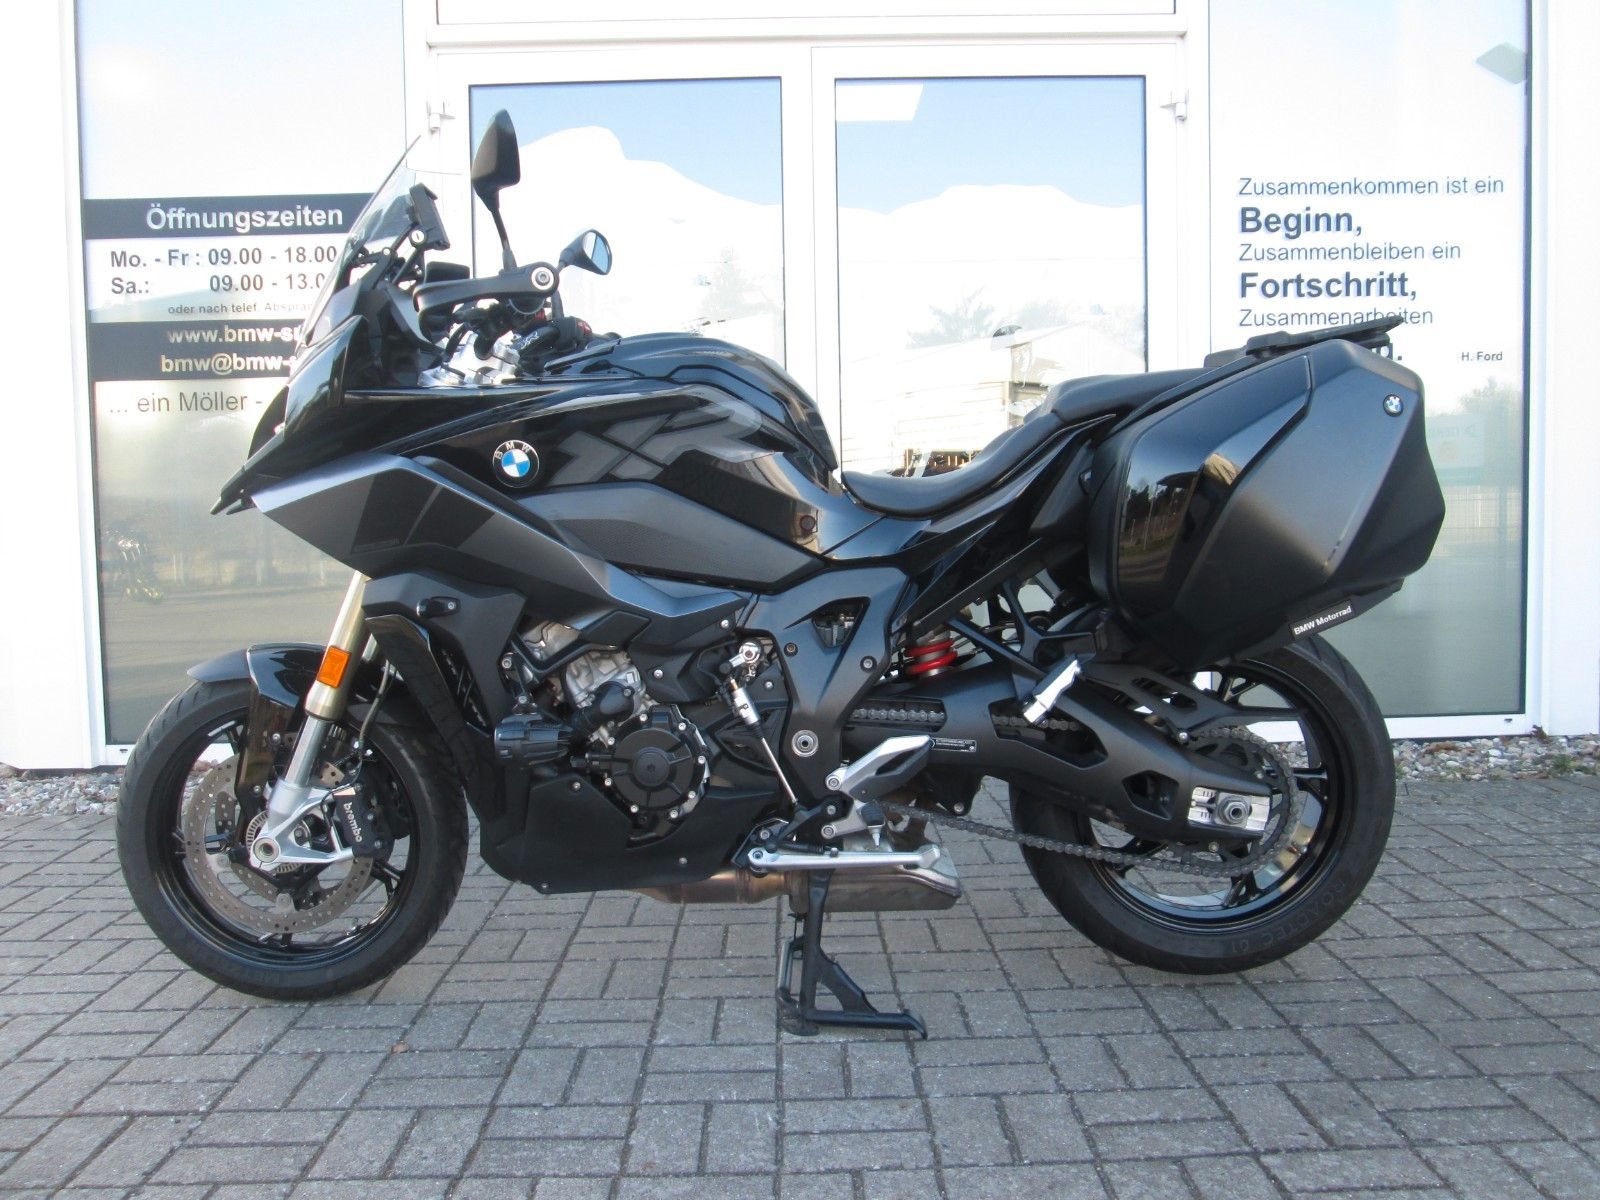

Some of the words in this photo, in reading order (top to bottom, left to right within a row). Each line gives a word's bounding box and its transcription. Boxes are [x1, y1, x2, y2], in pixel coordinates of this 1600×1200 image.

[1239, 177, 1438, 196] Zusammenkommen
[1446, 176, 1468, 194] ist
[1475, 176, 1504, 194] ein
[146, 203, 343, 233] Öffnungszeiten
[1240, 206, 1362, 239] Beginn,
[110, 250, 147, 268] Mo.
[208, 248, 262, 266] 09.00
[284, 246, 337, 263] 18.00
[1239, 242, 1425, 261] Zusammenbleiben
[1432, 242, 1461, 259] ein
[111, 277, 150, 294] Sa.:
[209, 274, 264, 292] 09.00
[286, 272, 326, 290] 13.0
[1240, 271, 1417, 301] Fortschritt,
[168, 304, 194, 315] oder
[199, 303, 227, 314] nach
[1461, 352, 1473, 361] H.
[1477, 351, 1503, 361] Ford
[137, 393, 170, 412] ein
[179, 391, 247, 412] Möller
[1294, 621, 1315, 635] BMW
[1315, 606, 1352, 626] Motorrad
[344, 802, 363, 842] brembo
